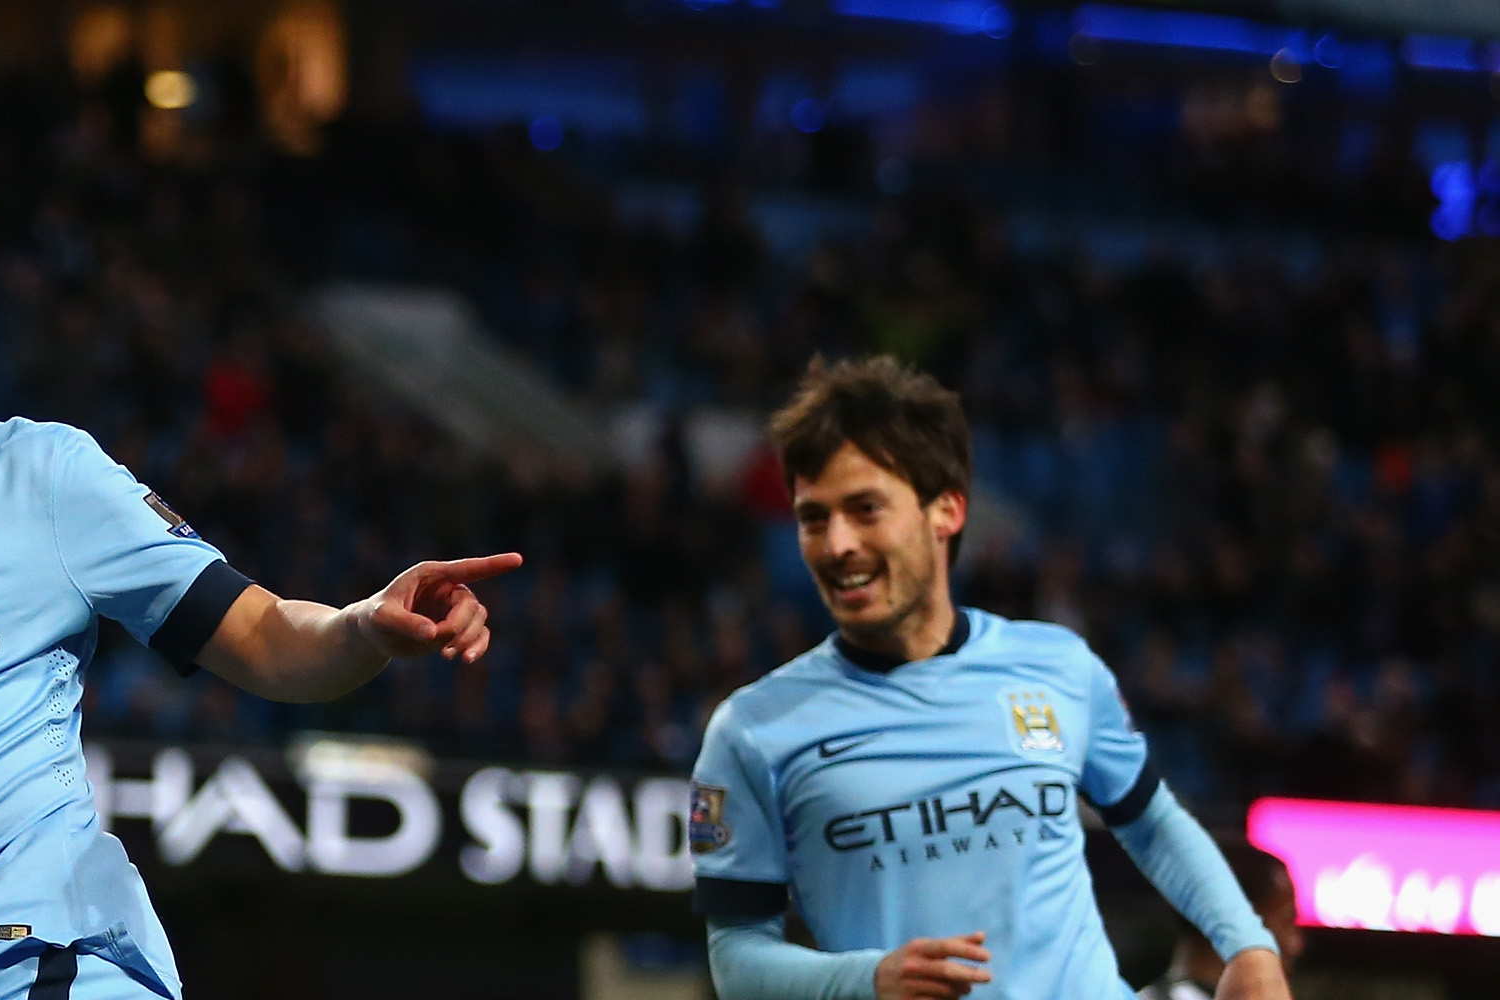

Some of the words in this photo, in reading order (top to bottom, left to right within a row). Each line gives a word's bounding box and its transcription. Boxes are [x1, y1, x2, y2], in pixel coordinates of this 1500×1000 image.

[85, 745, 442, 877] HAD
[459, 766, 696, 892] STAD
[823, 782, 1067, 850] ETIHAD
